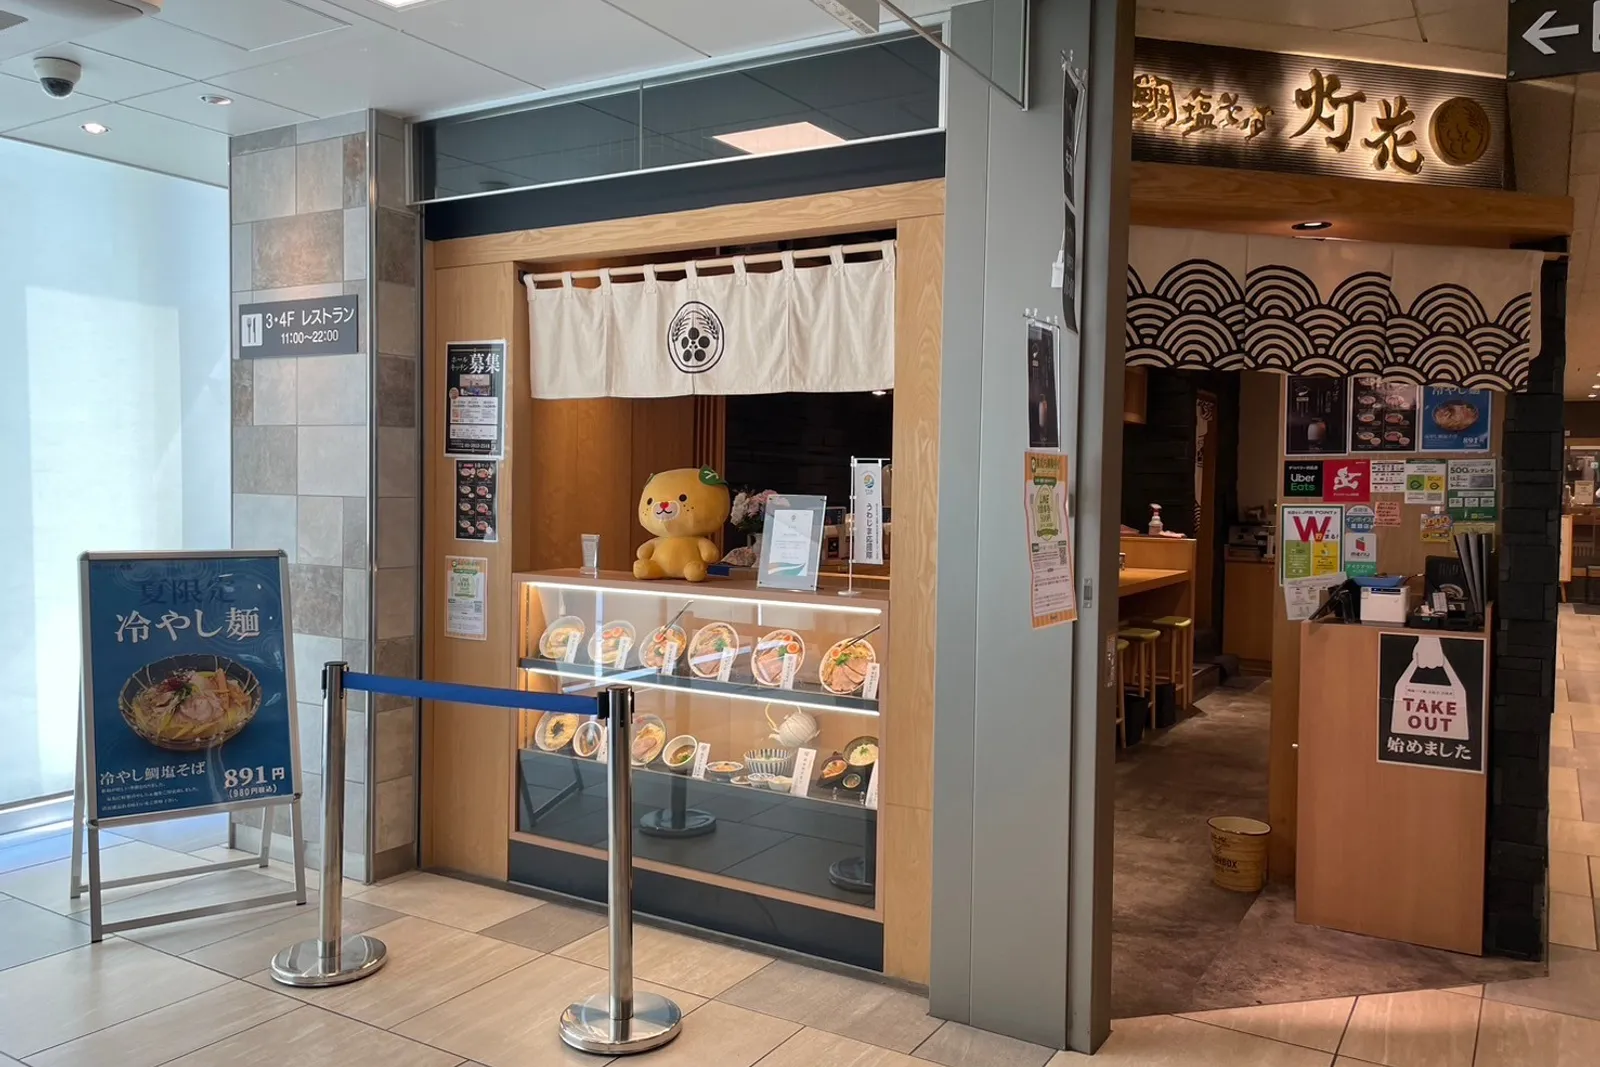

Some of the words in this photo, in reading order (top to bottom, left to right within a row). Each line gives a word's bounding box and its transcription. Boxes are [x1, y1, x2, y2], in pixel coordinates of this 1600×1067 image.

[1289, 68, 1425, 175] 灯花
[301, 307, 355, 326] レストラン
[469, 352, 500, 374] 募集
[1290, 473, 1315, 482] Uber
[1290, 483, 1315, 491] Eats
[1292, 515, 1332, 543] W
[140, 574, 236, 606] 夏限定
[114, 606, 261, 643] 冷やし麺
[1402, 697, 1457, 716] TAKE
[1407, 715, 1453, 732] OUT
[1387, 736, 1472, 760] 始めました
[99, 760, 206, 786] 冷やし鯛塩そば
